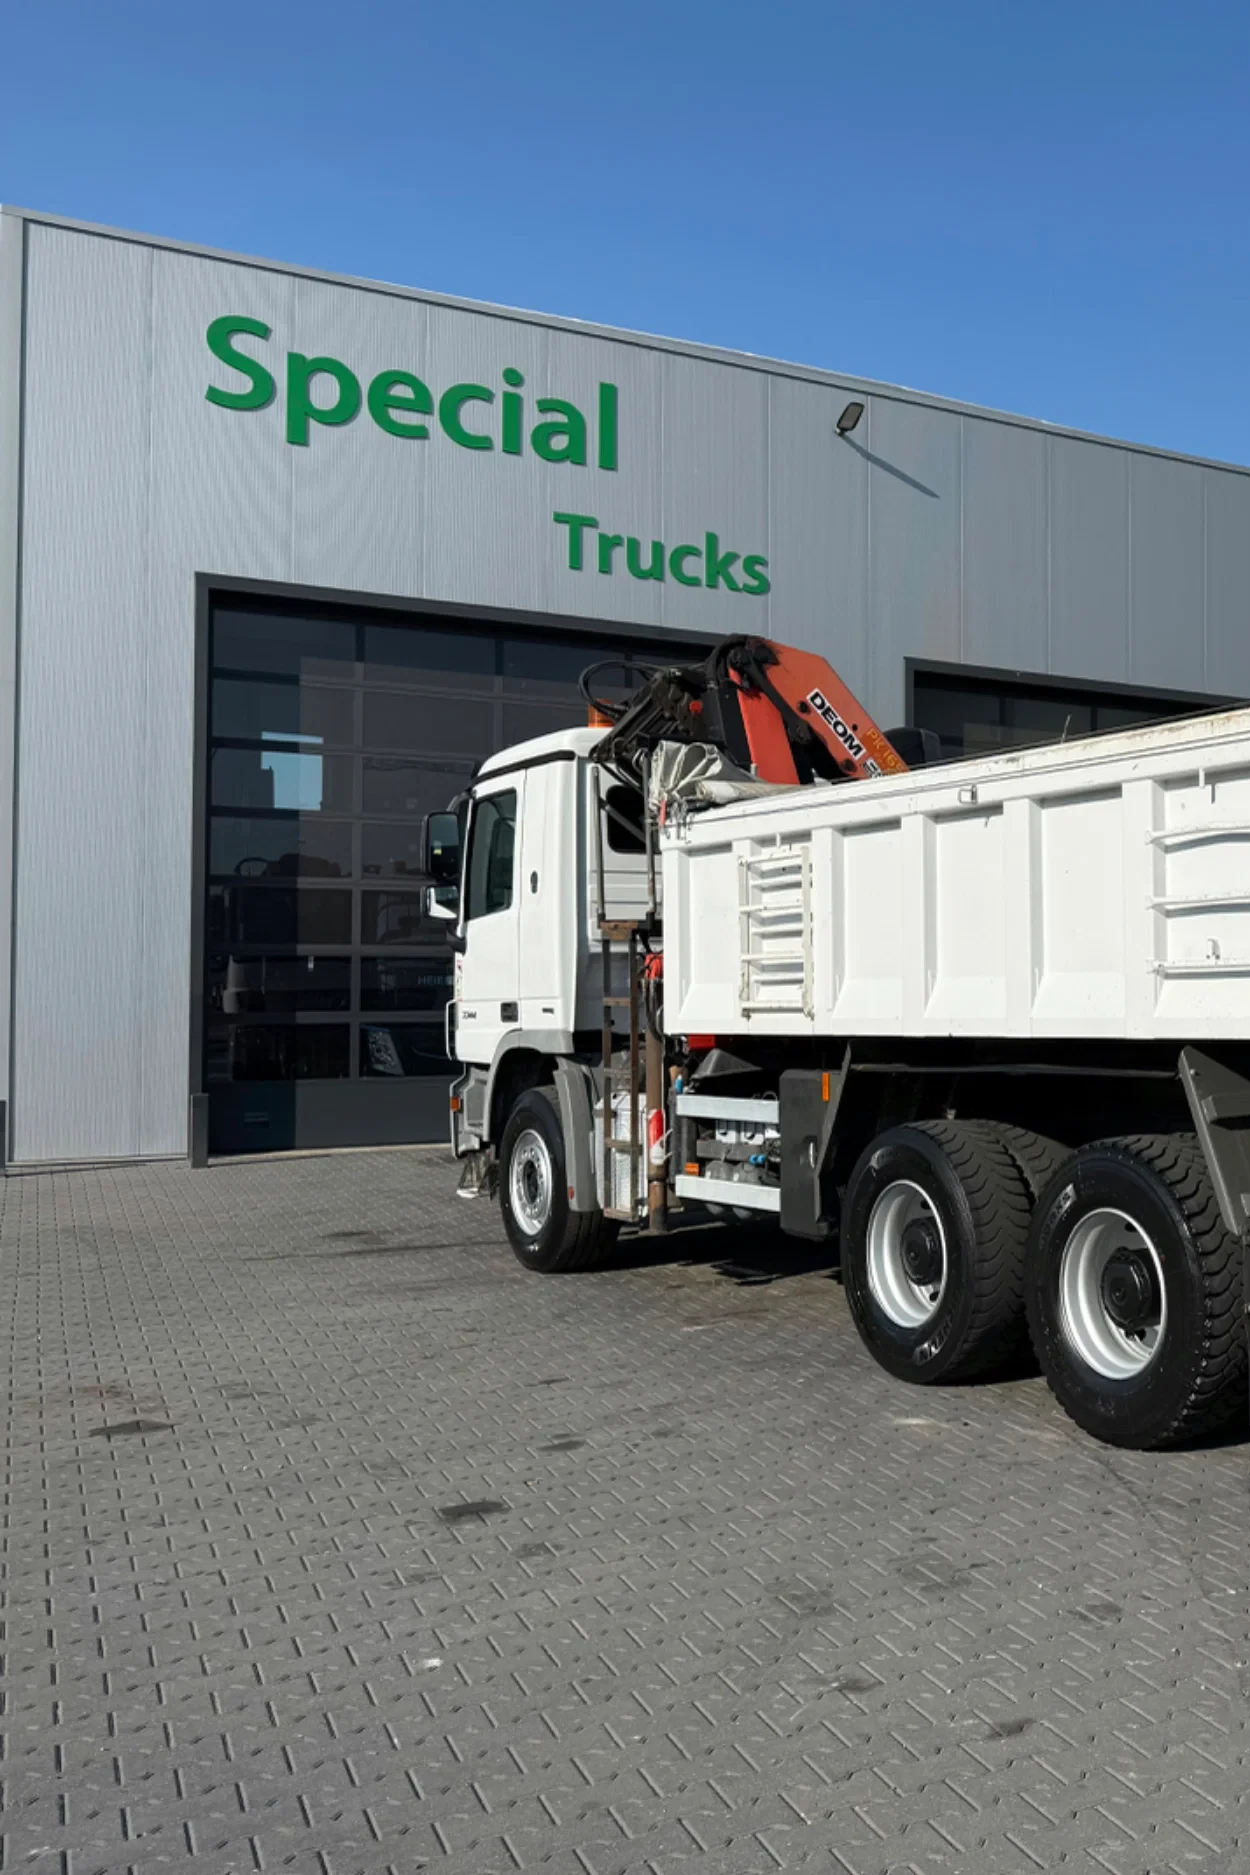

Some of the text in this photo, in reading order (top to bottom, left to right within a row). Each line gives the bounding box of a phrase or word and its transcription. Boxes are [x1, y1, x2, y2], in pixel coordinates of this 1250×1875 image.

[205, 314, 618, 471] Special
[553, 511, 771, 595] Trucks
[809, 691, 864, 758] DEOM
